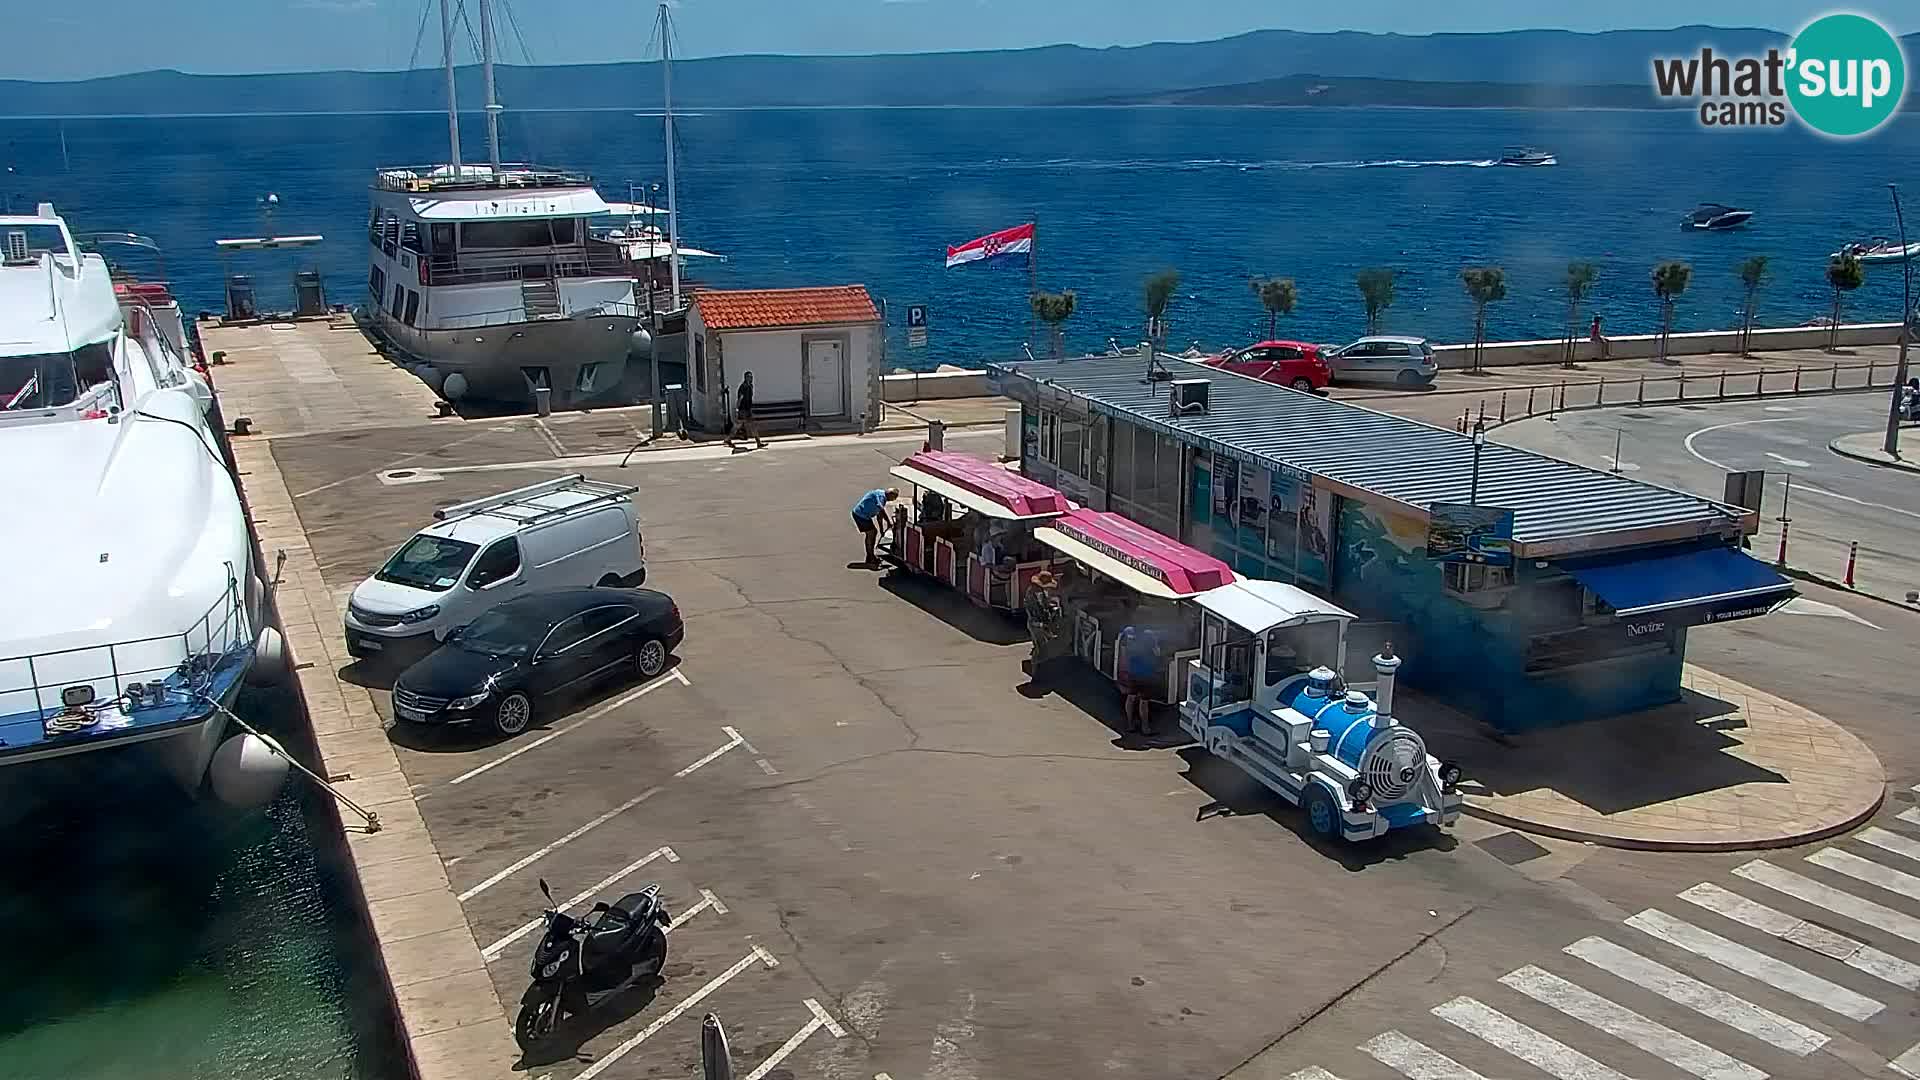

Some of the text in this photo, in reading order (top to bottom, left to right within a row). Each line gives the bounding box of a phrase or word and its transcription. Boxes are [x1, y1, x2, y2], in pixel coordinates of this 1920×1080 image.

[912, 308, 921, 325] P
[1223, 445, 1254, 464] STATION
[1256, 455, 1280, 473] TICKET
[1281, 466, 1307, 481] OFFICE
